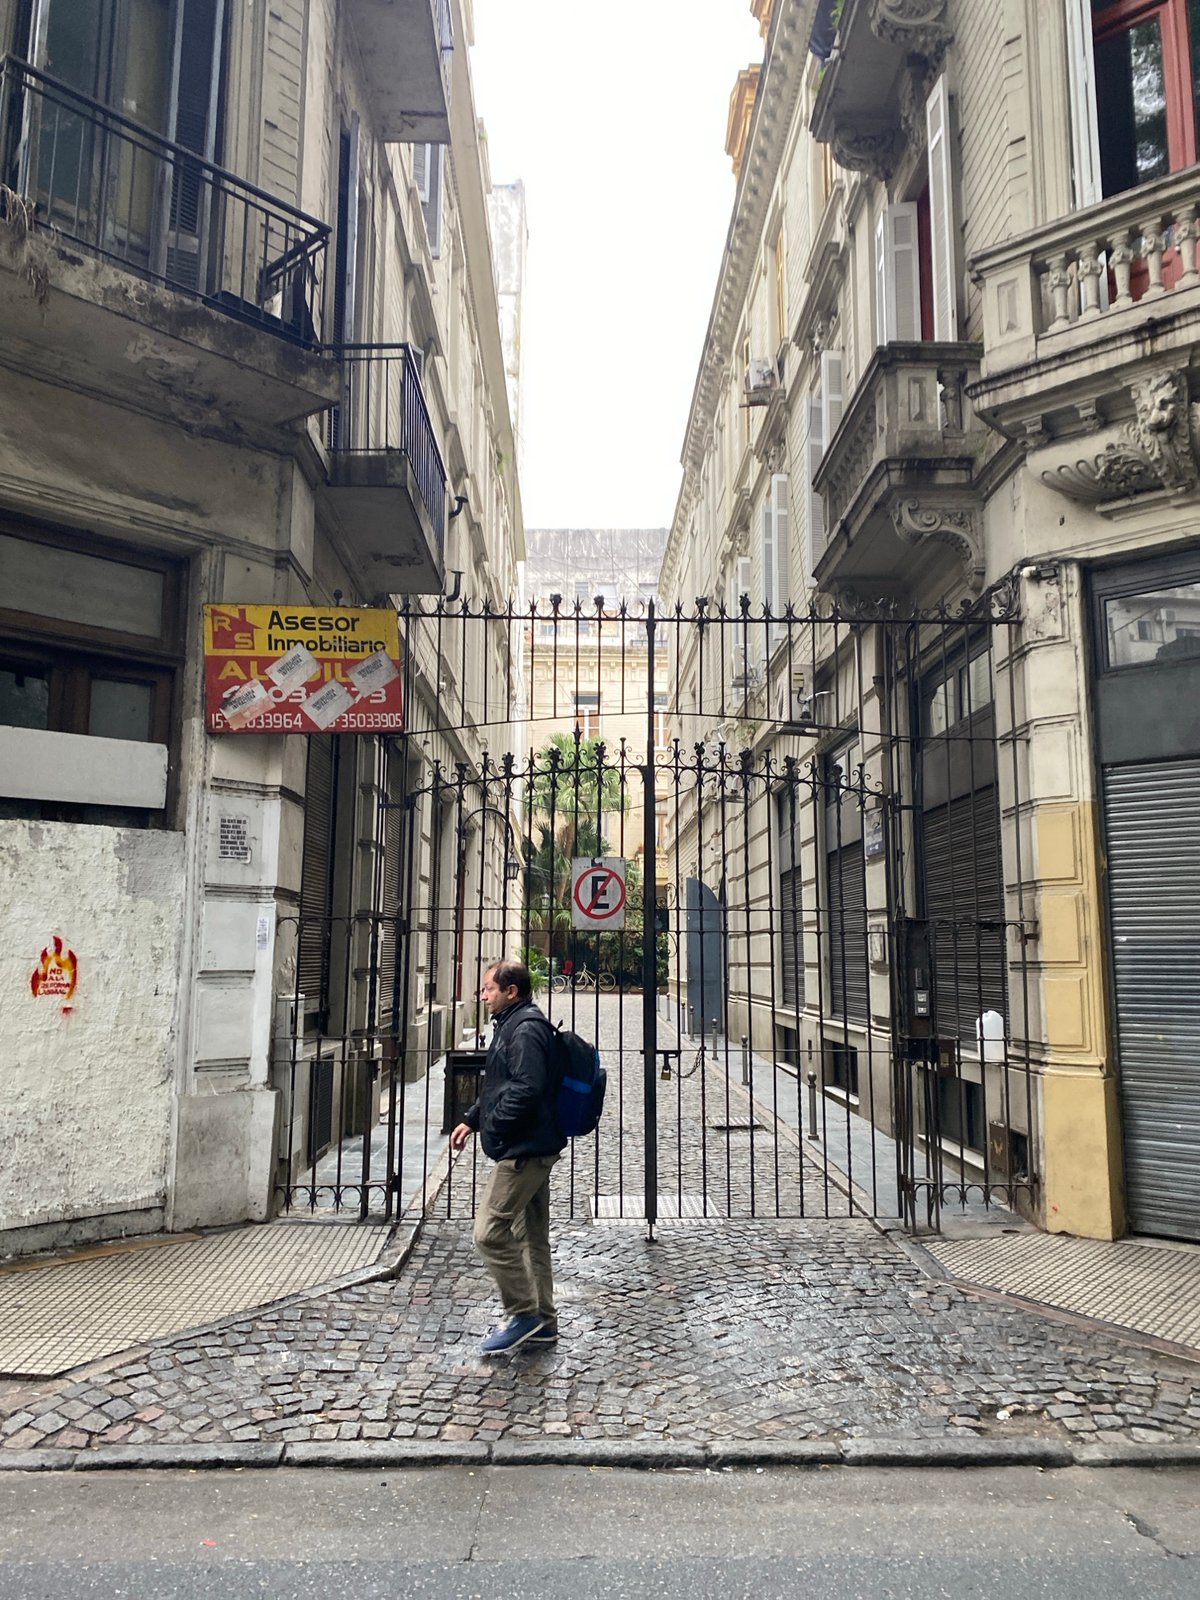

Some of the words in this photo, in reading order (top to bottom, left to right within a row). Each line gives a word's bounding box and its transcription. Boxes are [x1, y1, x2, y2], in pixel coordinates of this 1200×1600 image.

[268, 610, 360, 632] Asesor
[268, 634, 386, 653] Inmobiliario
[592, 876, 610, 909] E
